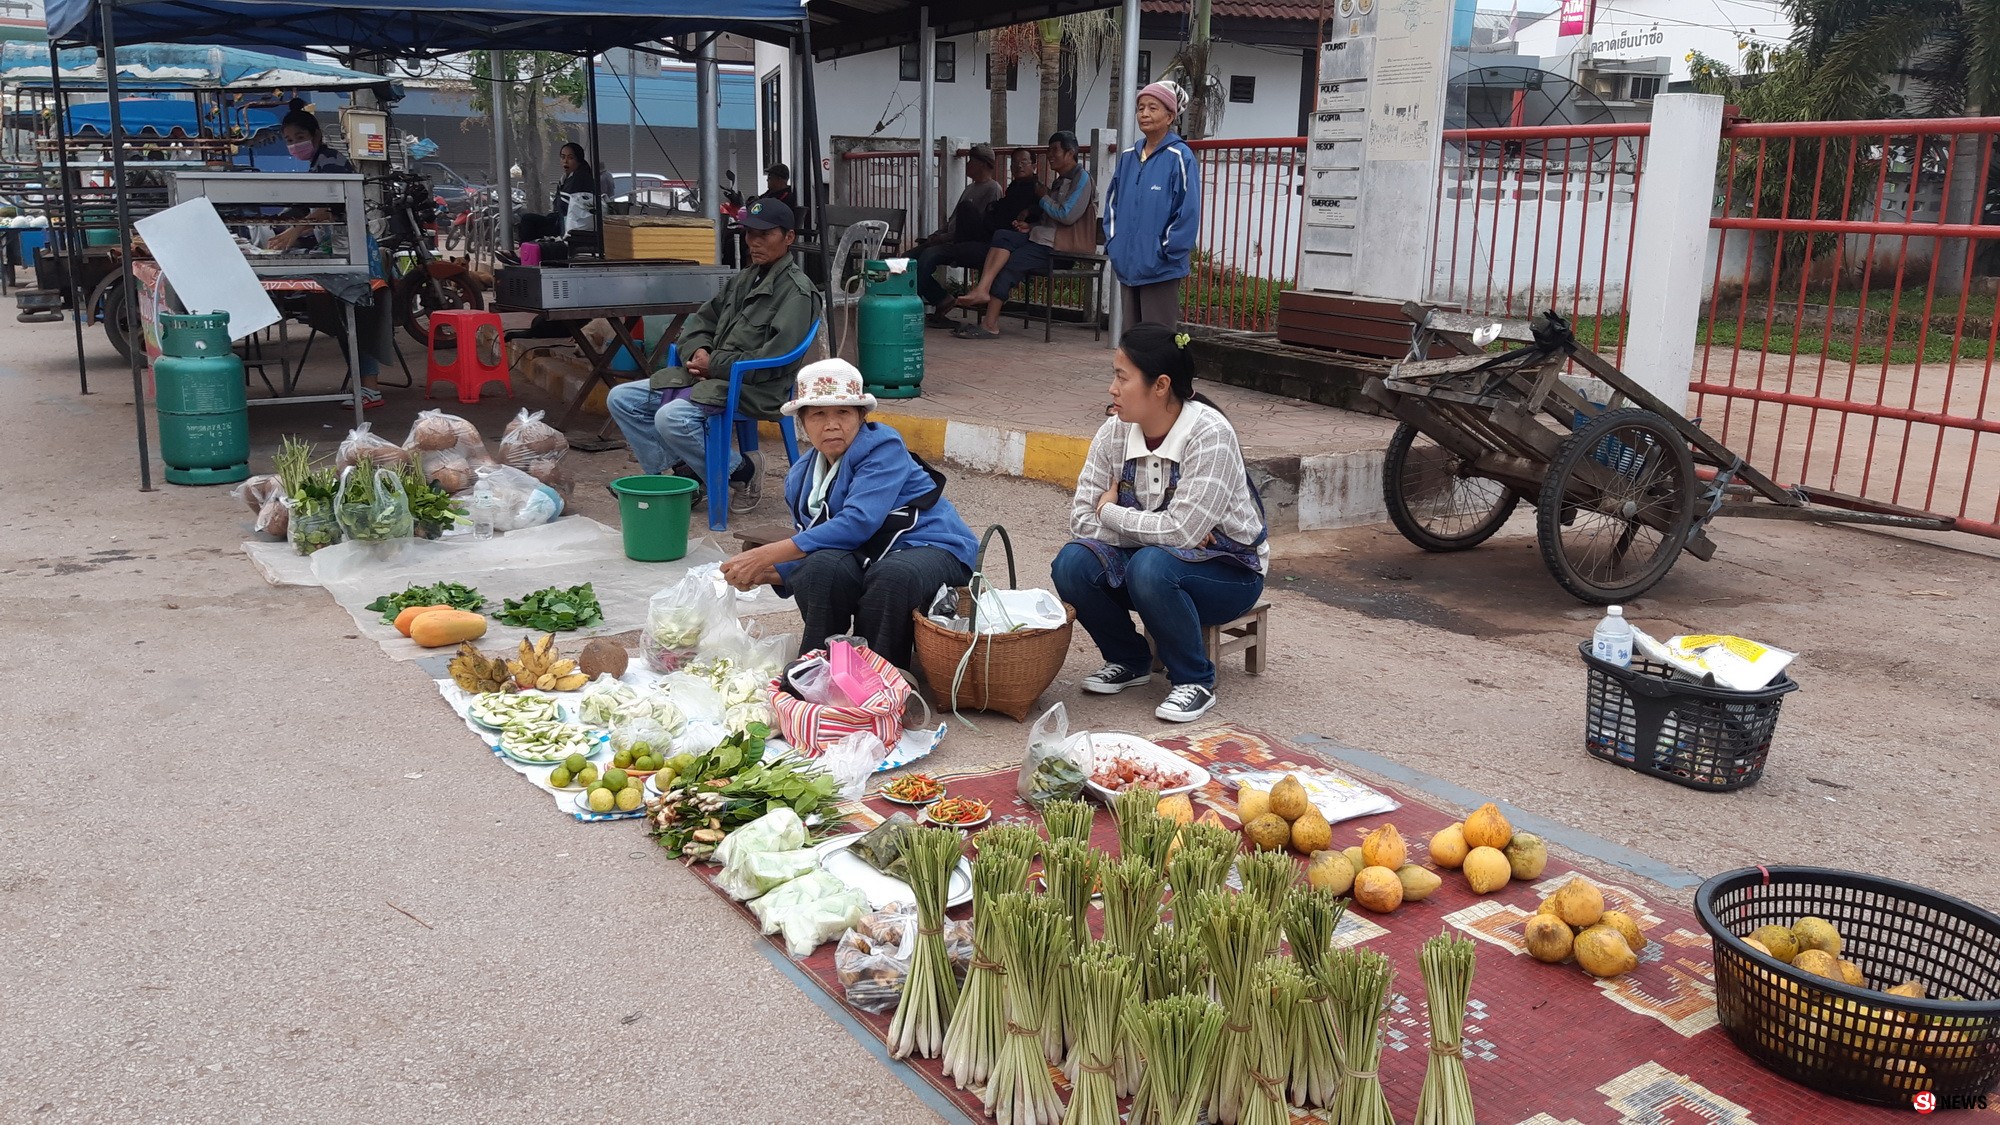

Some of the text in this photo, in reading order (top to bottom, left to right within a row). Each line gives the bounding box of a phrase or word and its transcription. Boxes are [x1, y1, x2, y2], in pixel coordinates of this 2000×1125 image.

[1563, 0, 1584, 14] ATM
[1324, 41, 1347, 52] TOURIST
[1320, 84, 1340, 94] POLICE
[1318, 113, 1341, 122] HOSPITA
[1315, 142, 1335, 151] RESOR
[1311, 199, 1341, 208] EMERGENC
